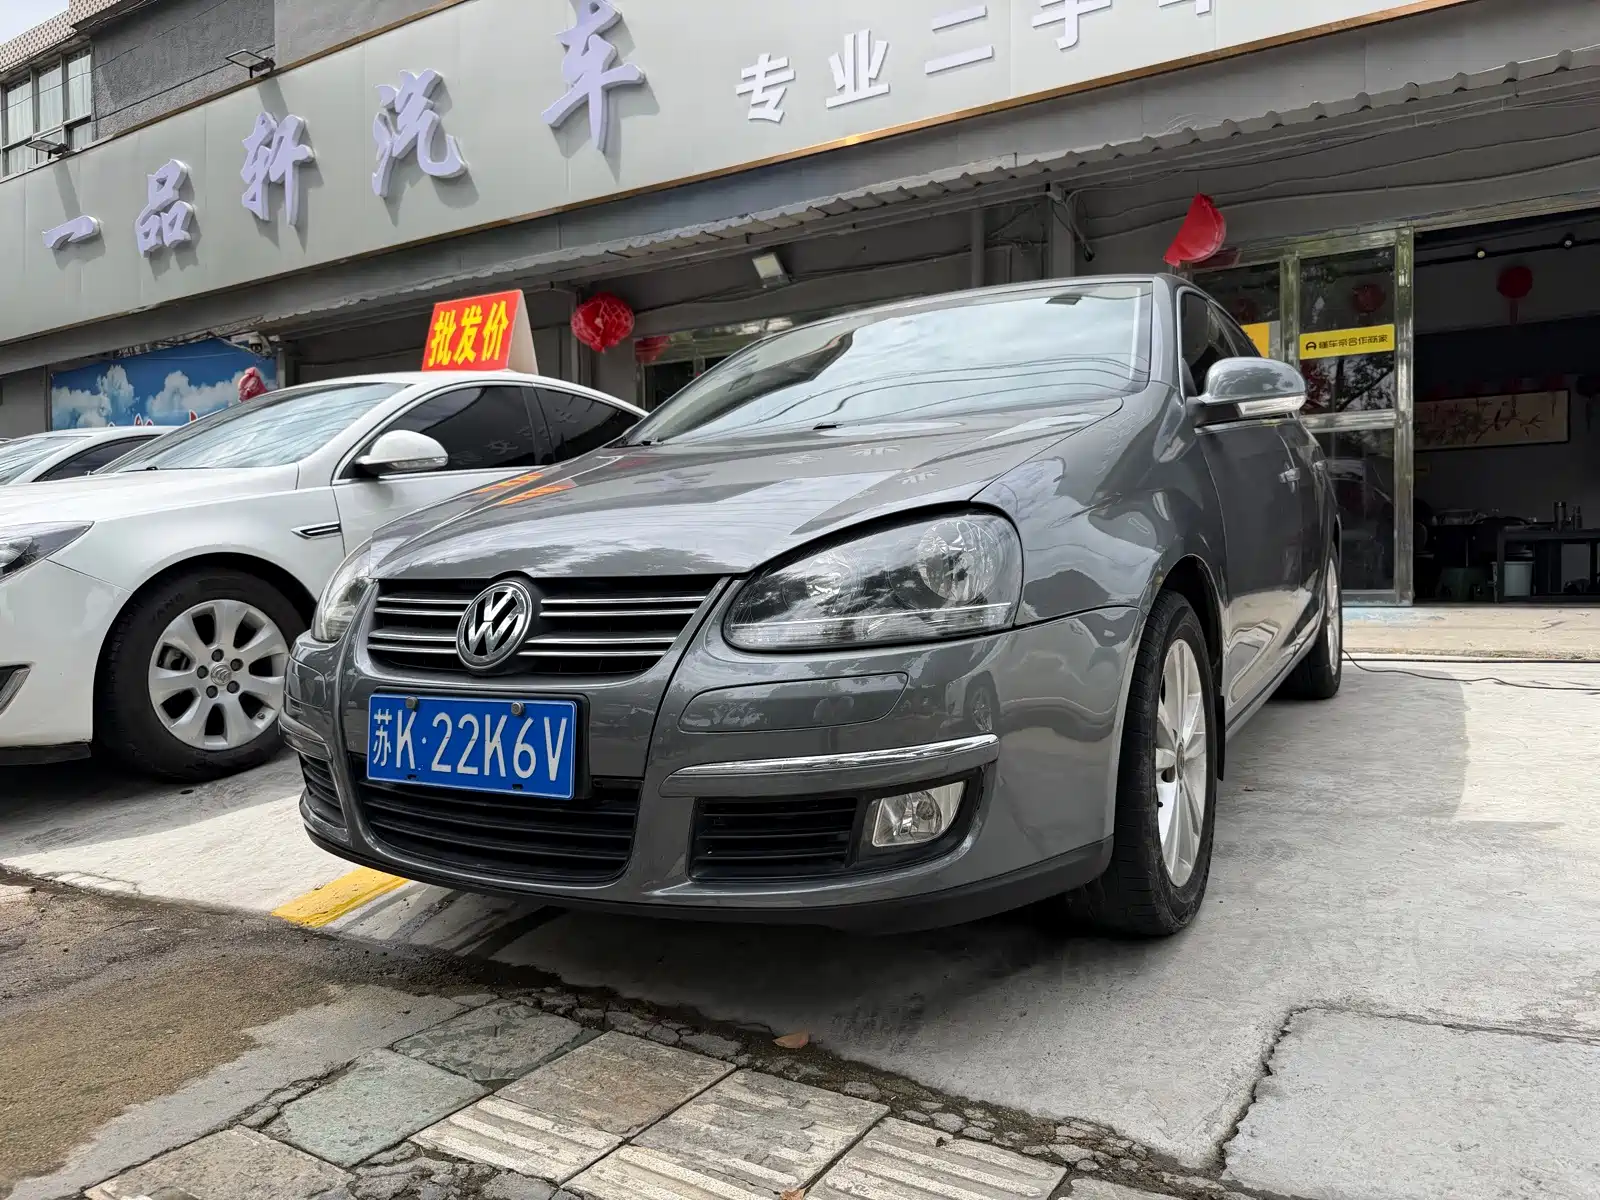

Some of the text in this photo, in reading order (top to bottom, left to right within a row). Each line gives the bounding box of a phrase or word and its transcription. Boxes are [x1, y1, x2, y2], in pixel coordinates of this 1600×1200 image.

[735, 0, 1212, 123] 专业二手
[42, 0, 645, 257] 一品轩汽车
[428, 300, 509, 367] 批发价
